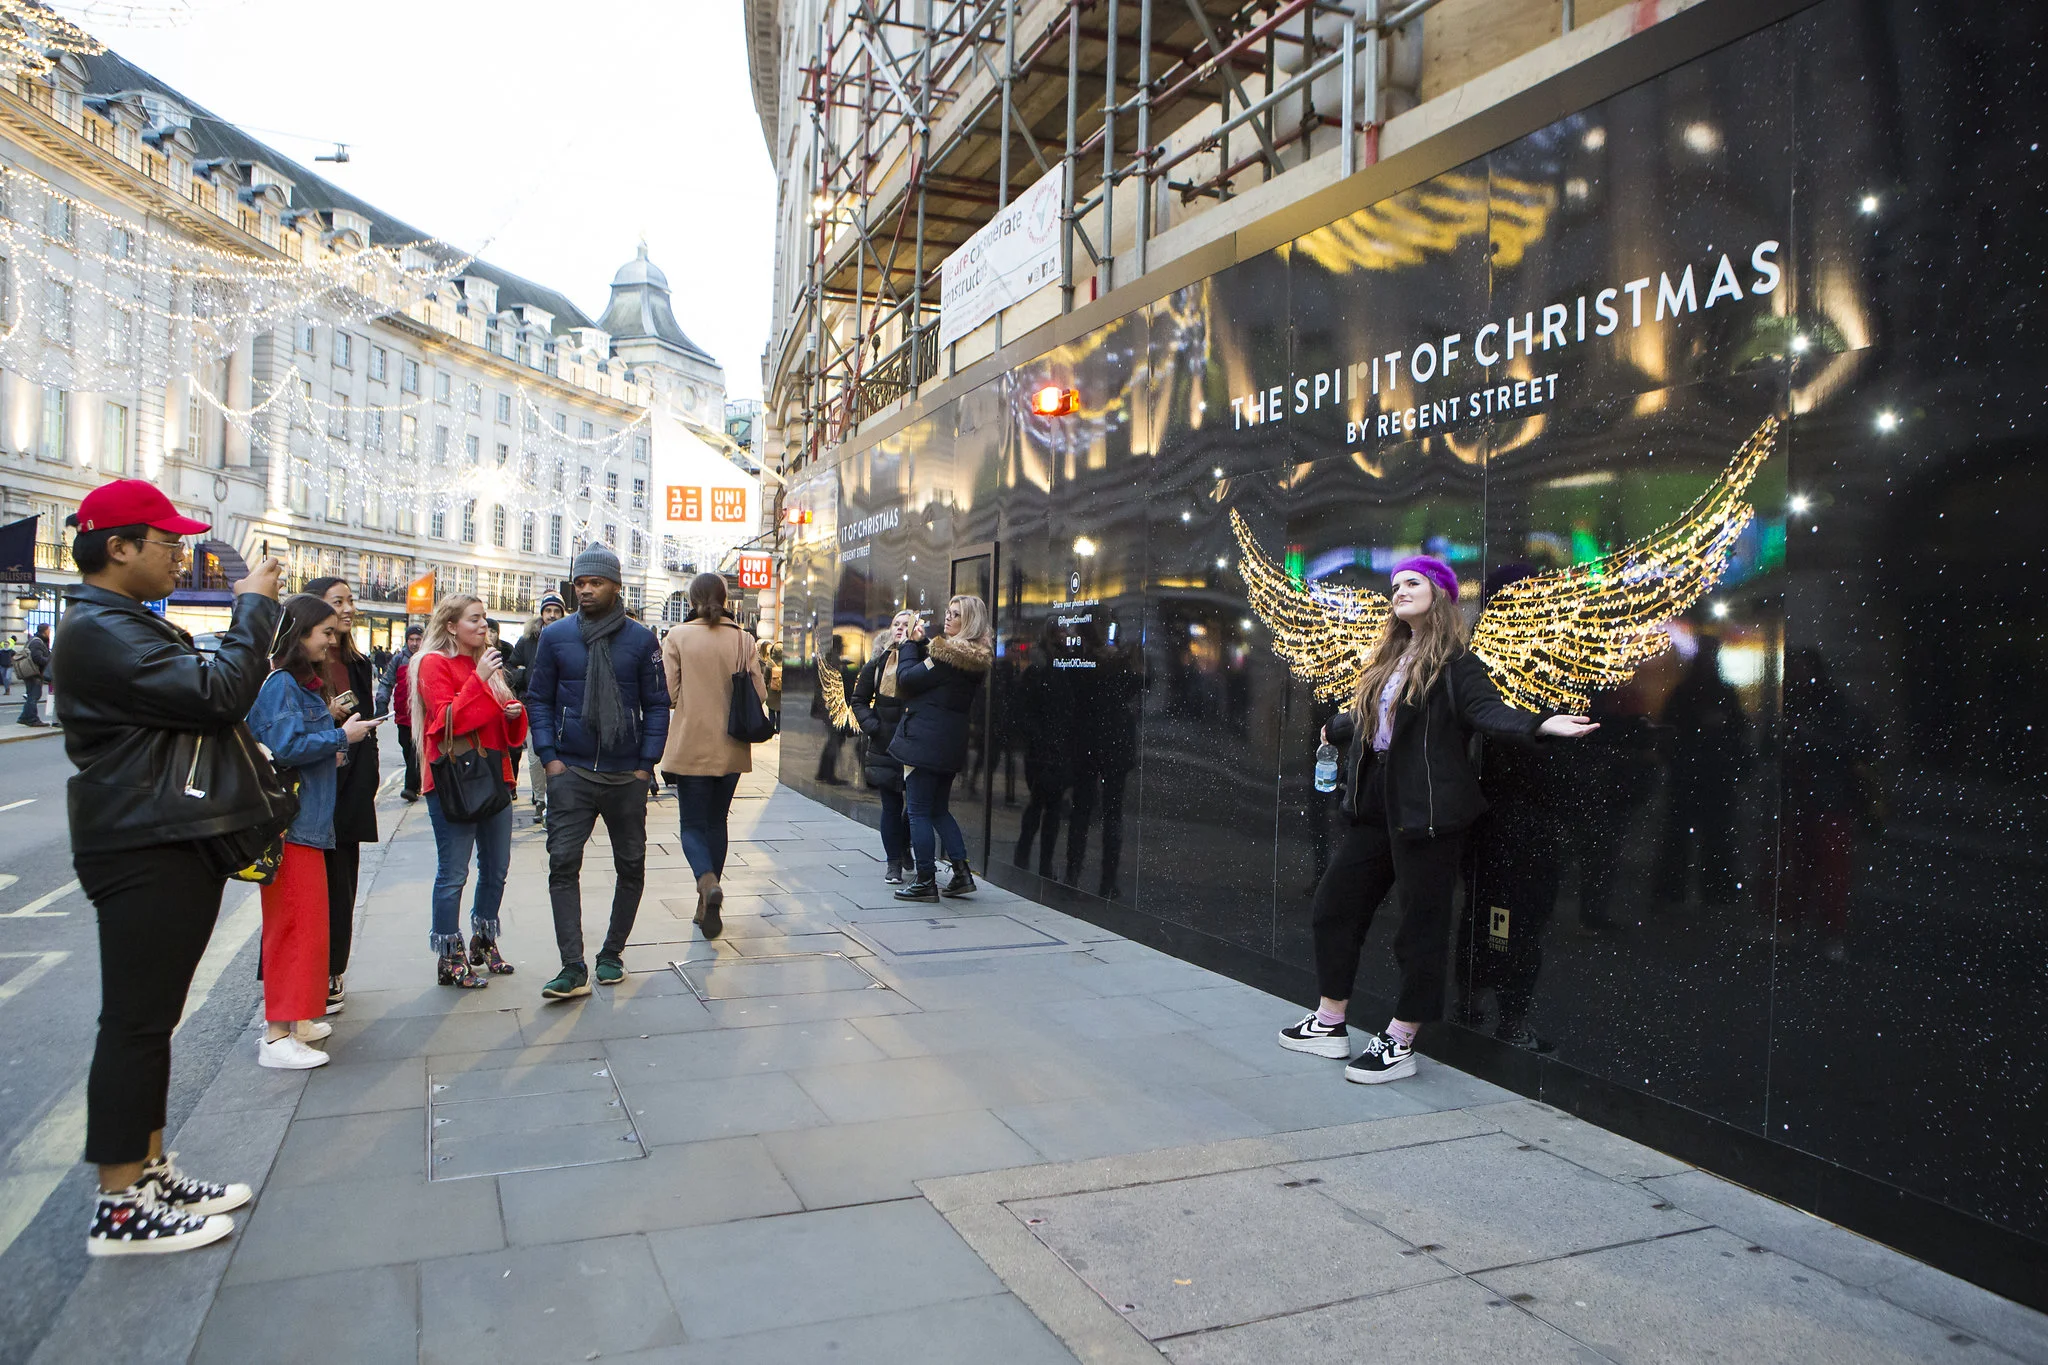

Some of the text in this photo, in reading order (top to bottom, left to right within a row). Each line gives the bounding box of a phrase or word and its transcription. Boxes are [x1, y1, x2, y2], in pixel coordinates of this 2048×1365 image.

[1232, 386, 1283, 431] THE
[1411, 334, 1461, 383] OF
[1474, 240, 1781, 365] CHRISTMAS
[1346, 374, 1560, 443] BY REGENT STREET
[848, 522, 857, 541] OF
[858, 507, 899, 538] CHRISTMAS
[743, 559, 766, 572] UNI
[743, 573, 768, 587] QLO
